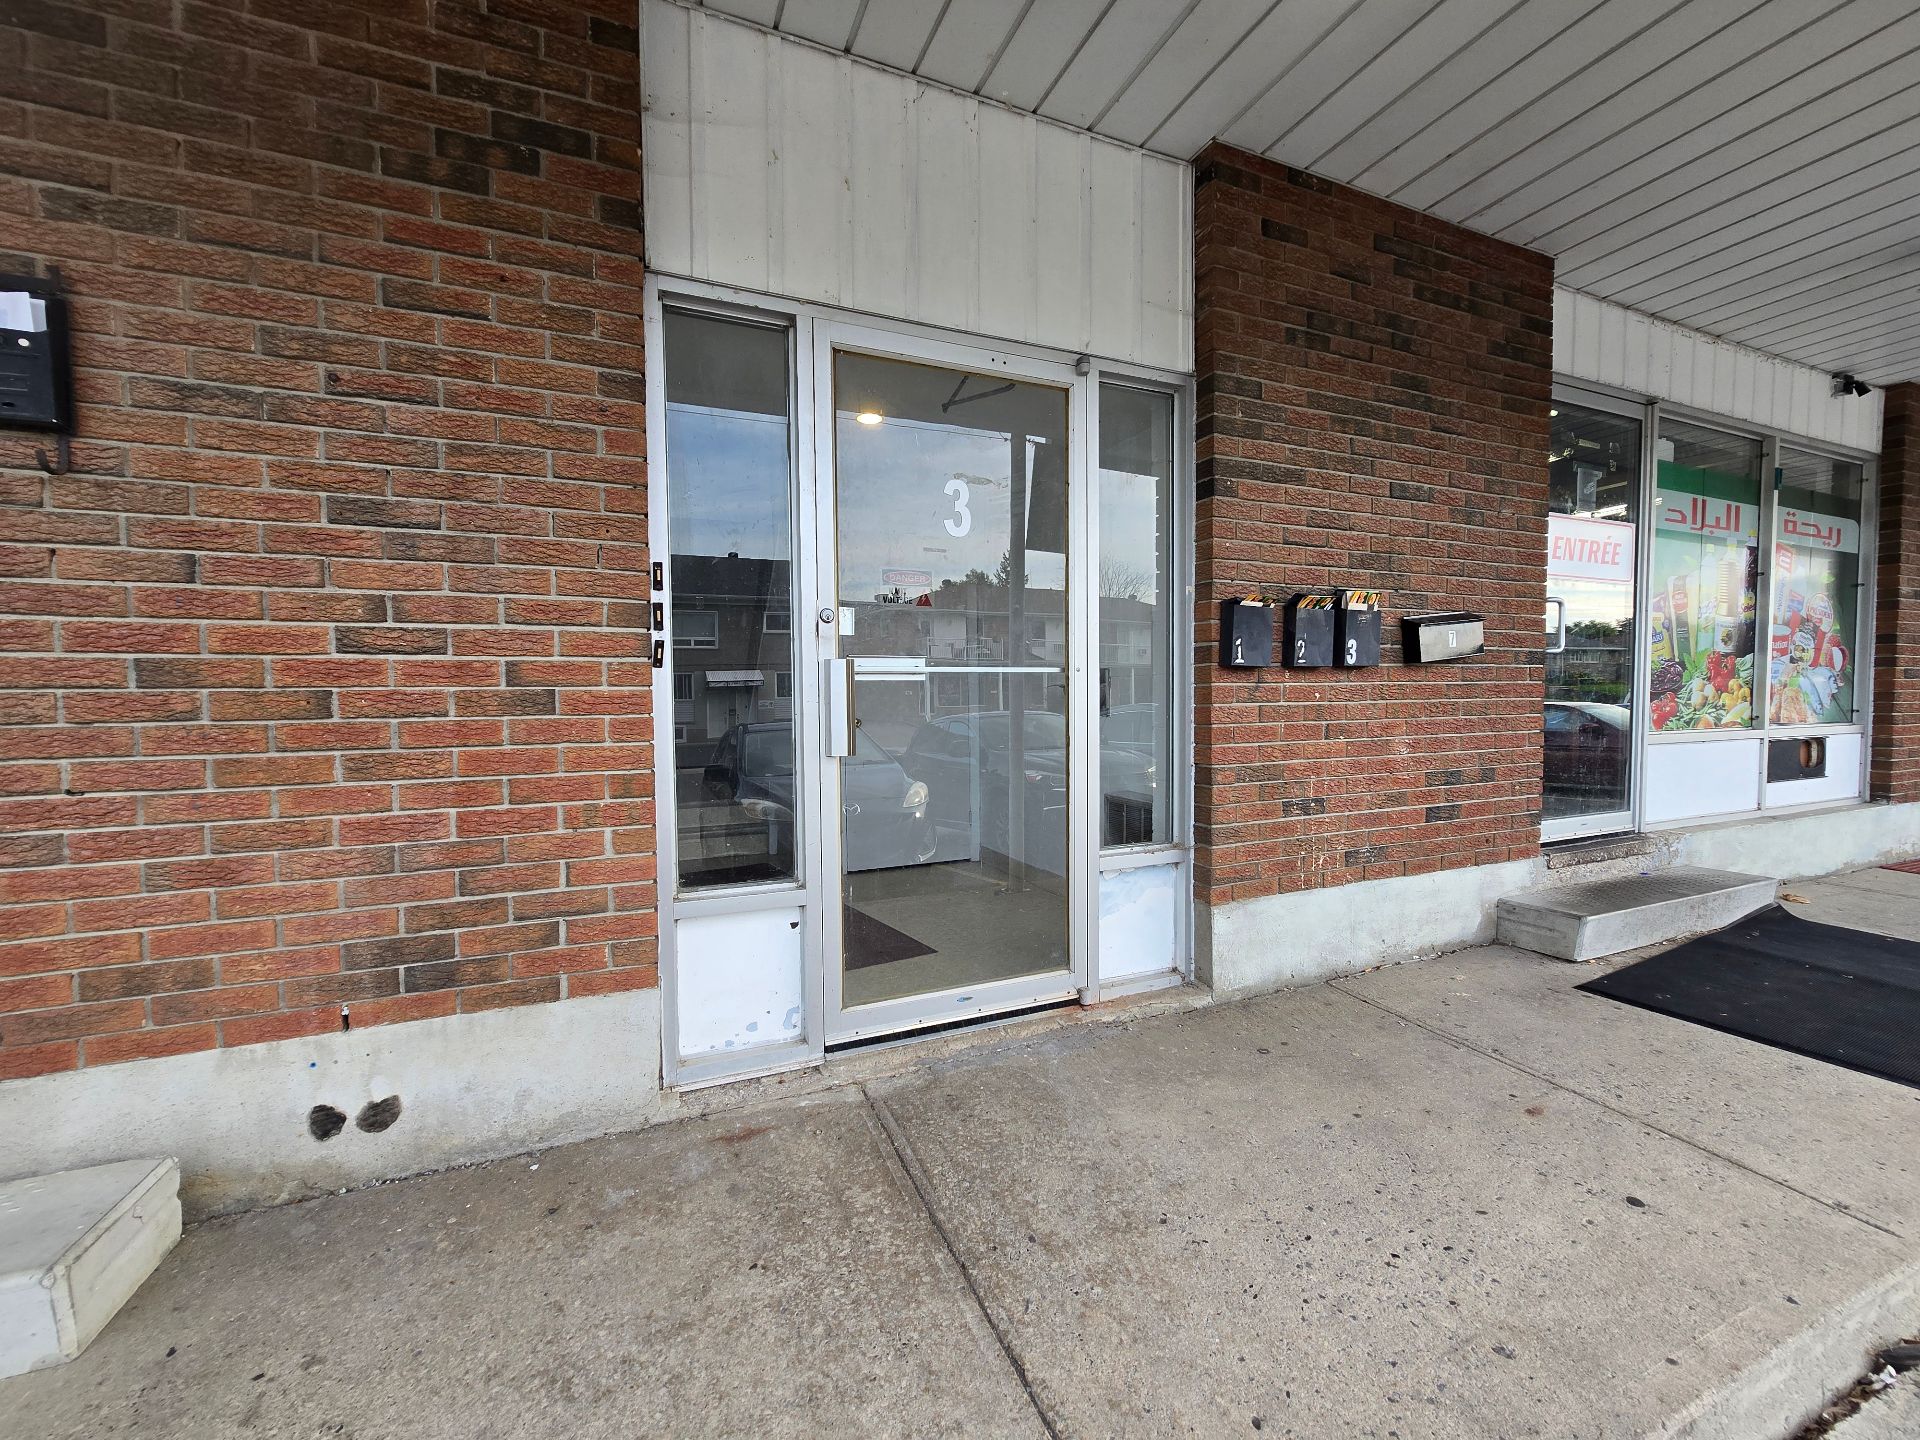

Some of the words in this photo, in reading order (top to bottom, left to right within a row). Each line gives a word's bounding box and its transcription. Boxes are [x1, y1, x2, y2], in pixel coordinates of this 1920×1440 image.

[944, 479, 971, 537] 3
[1664, 497, 1741, 535] البلاد
[1783, 511, 1842, 548] ريحة
[1551, 535, 1622, 566] ENTRÉE
[889, 573, 926, 583] DANGER
[1233, 638, 1245, 664] 1
[1297, 639, 1306, 664] 2
[1346, 638, 1357, 665] 3
